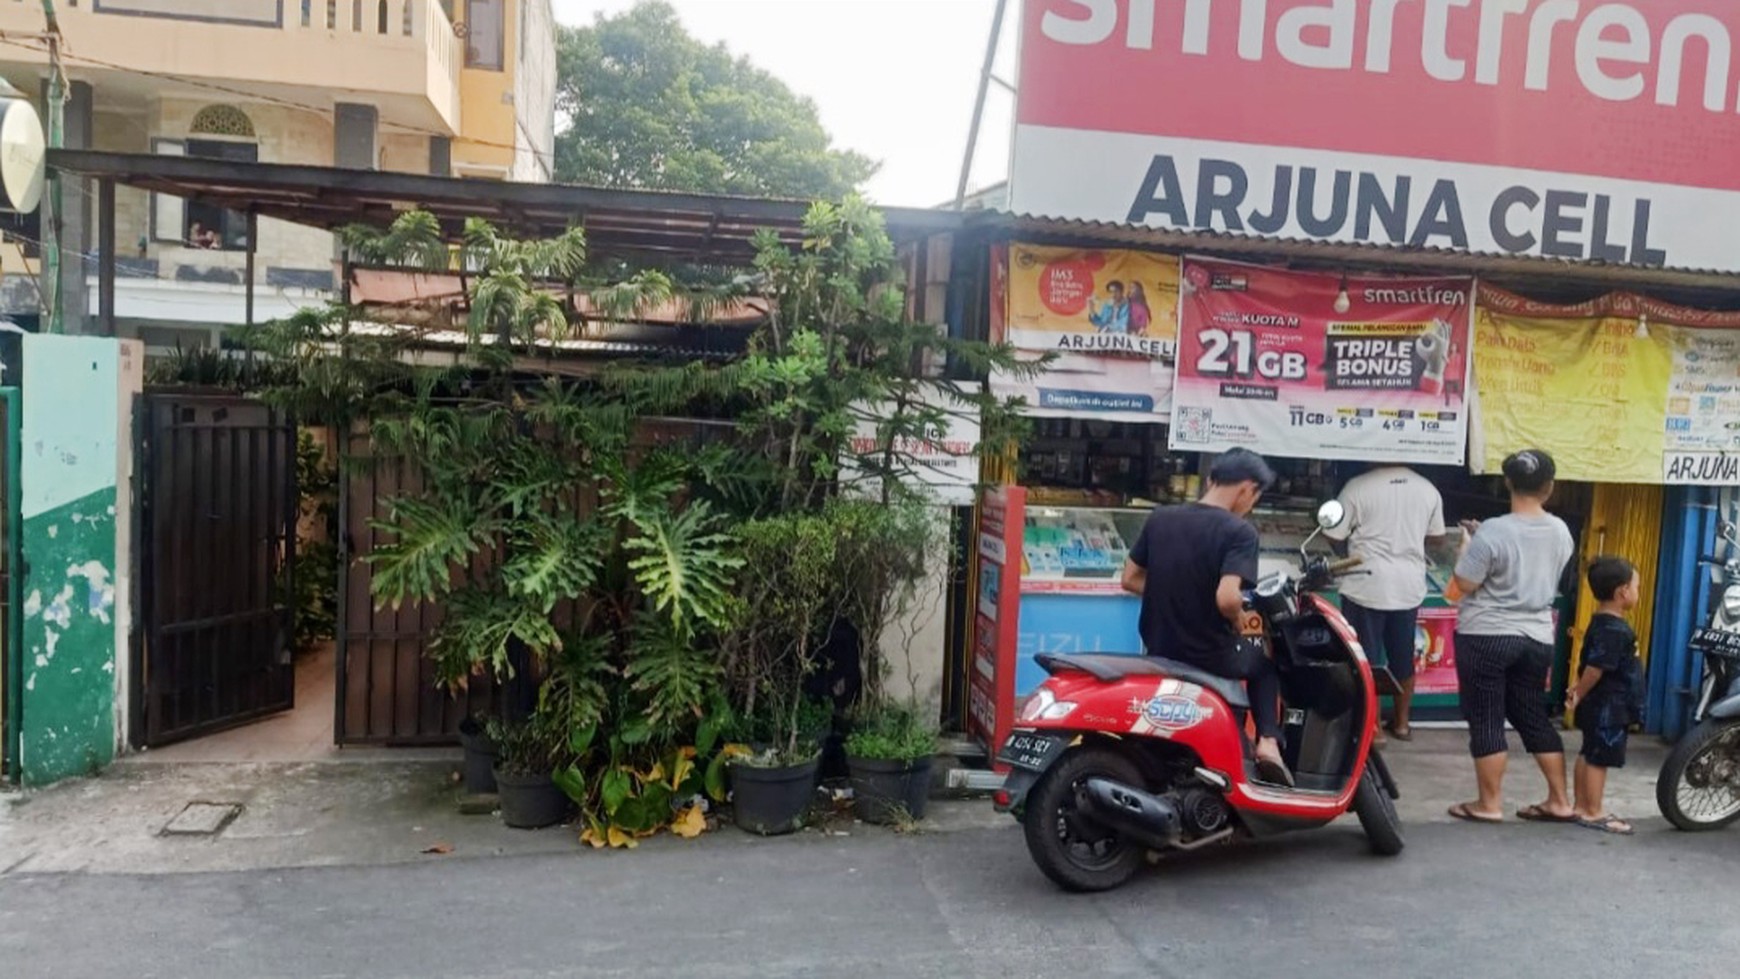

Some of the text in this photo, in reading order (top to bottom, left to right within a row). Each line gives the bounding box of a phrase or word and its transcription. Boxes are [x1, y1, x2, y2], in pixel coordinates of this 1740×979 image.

[1126, 155, 1667, 264] ARJUNA CELL
[1364, 286, 1465, 306] smartfren
[1241, 314, 1285, 326] KUOTA
[1058, 335, 1133, 350] ARJUNA
[1333, 339, 1413, 358] TRIPLE
[1198, 328, 1306, 379] 21 GB
[1336, 358, 1413, 376] BONUS
[1289, 410, 1303, 427] 11
[1667, 455, 1739, 481] ARJUNA
